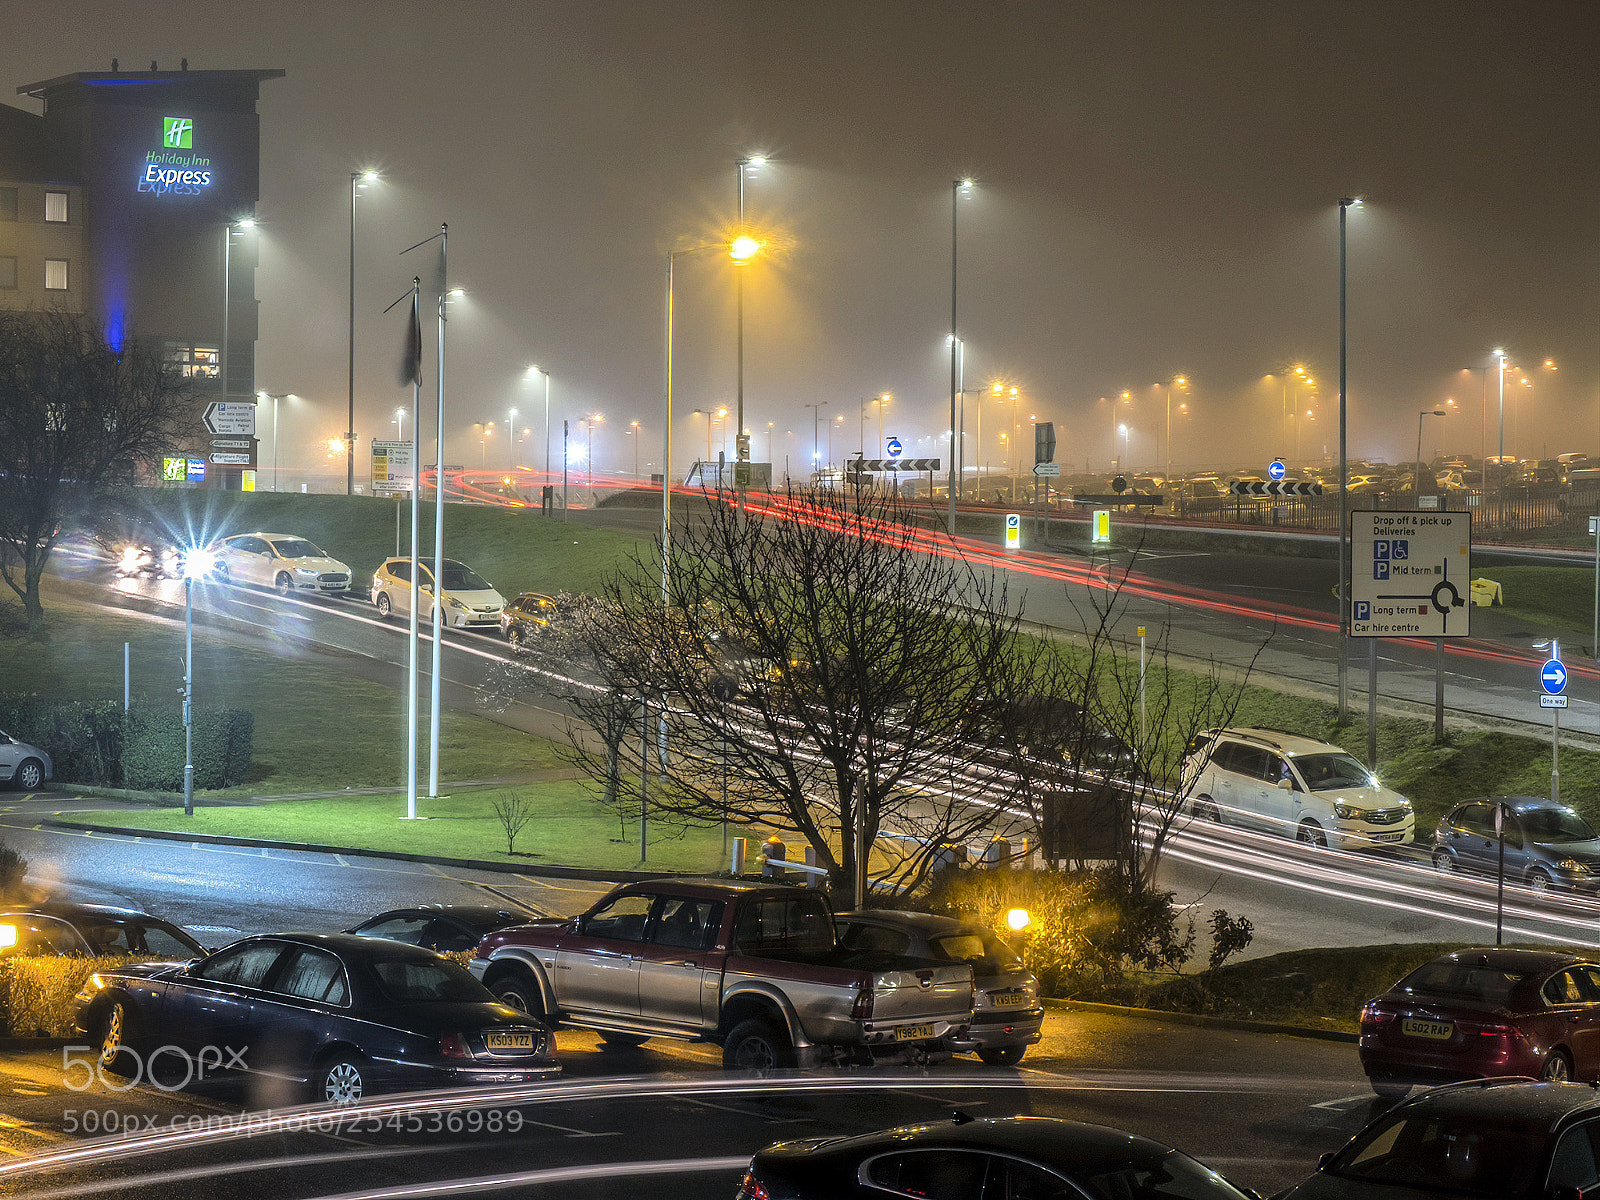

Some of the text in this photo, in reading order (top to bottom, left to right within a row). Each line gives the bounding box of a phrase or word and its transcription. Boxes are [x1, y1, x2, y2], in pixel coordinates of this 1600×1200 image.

[145, 150, 210, 168] Holiday Inn
[145, 164, 211, 187] Express
[1373, 515, 1452, 527] Drop off & pick up
[1373, 526, 1416, 536] Deliveries
[1392, 565, 1409, 575] Mid
[1411, 566, 1432, 575] term
[1373, 605, 1394, 616] Long
[1396, 606, 1417, 614] term
[1354, 623, 1420, 632] Car hire centre
[897, 1025, 933, 1039] Y982 YAJ
[1405, 1021, 1450, 1036] LS02 RAP
[490, 1035, 530, 1046] KS03 YZZ
